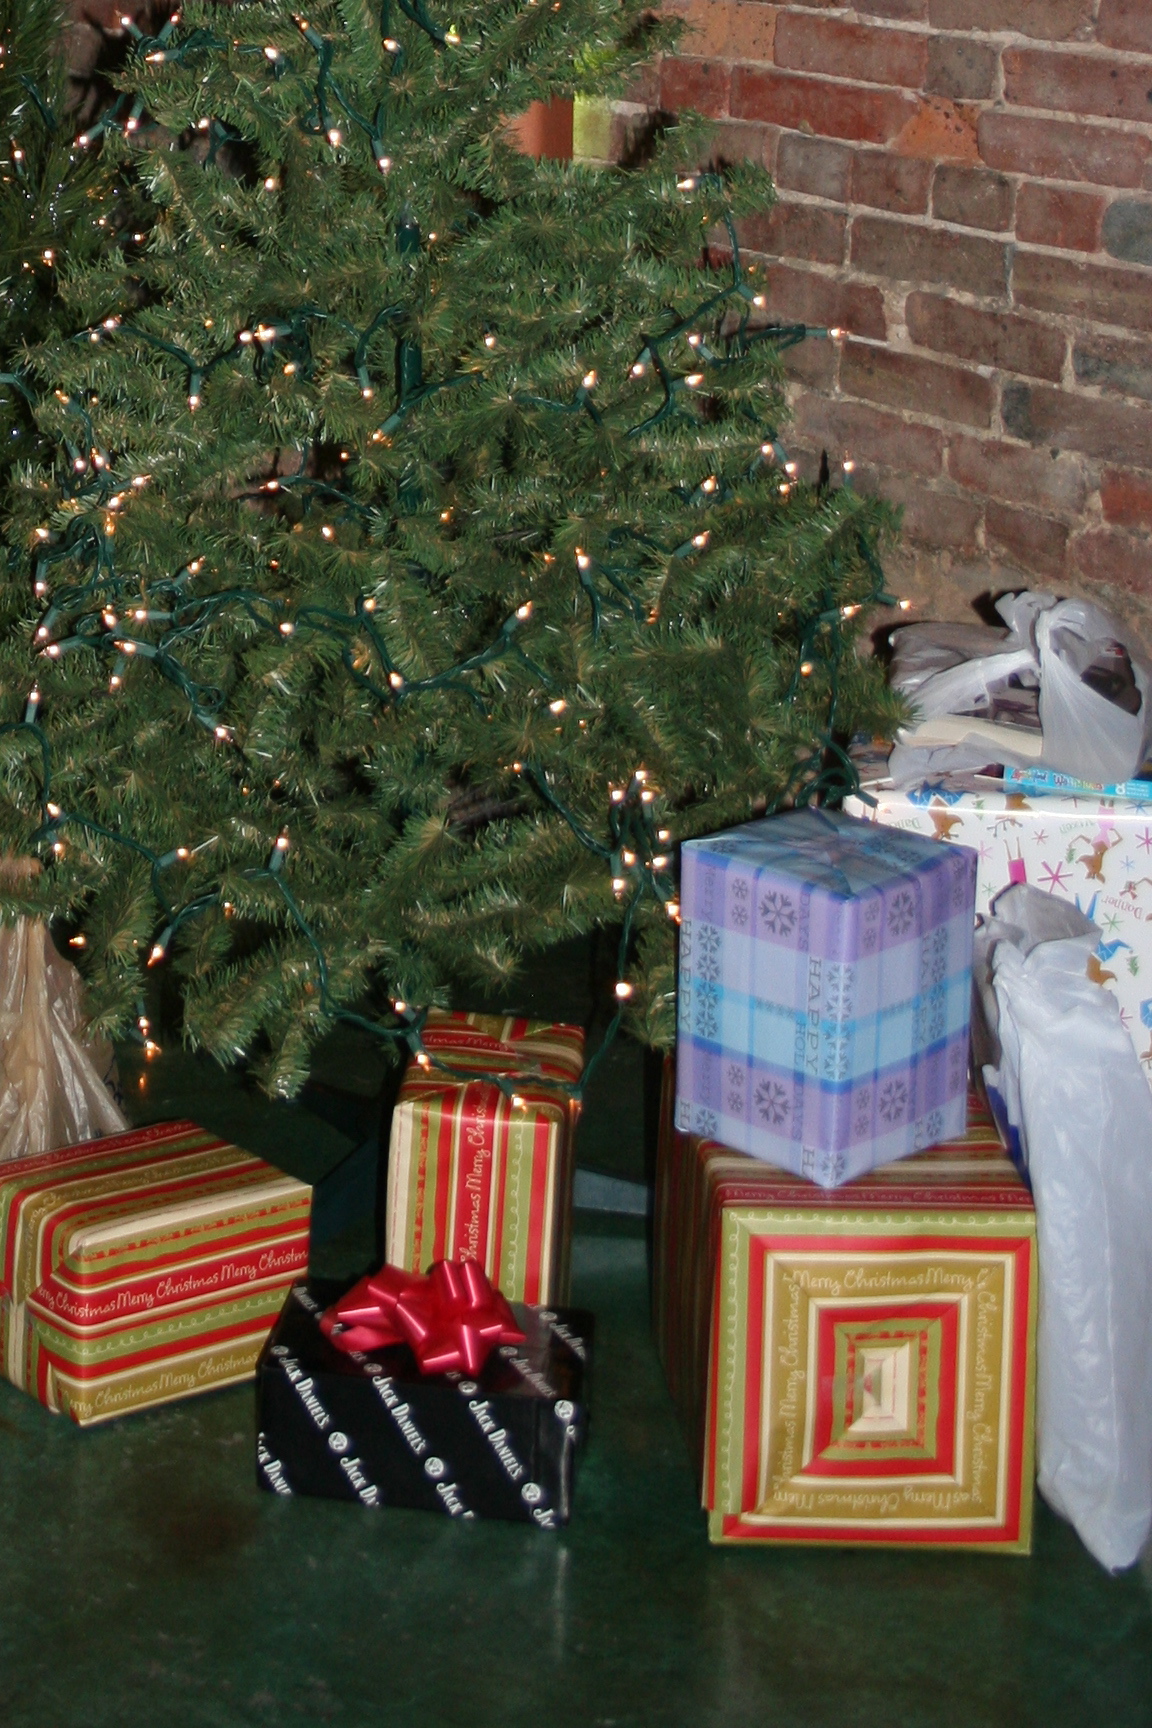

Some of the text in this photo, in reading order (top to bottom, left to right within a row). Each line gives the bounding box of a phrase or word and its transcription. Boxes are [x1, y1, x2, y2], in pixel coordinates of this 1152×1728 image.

[677, 919, 693, 1033] HAPPY
[804, 956, 823, 1077] HAPPY
[465, 1147, 491, 1192] Merry
[55, 1292, 118, 1318] Christmas
[116, 1291, 155, 1310] Merry
[156, 1272, 220, 1298] Christmas
[220, 1264, 258, 1282] Merry
[258, 1248, 308, 1272] Christm
[797, 1267, 974, 1295] Merry Christmas Merry
[975, 1290, 997, 1372] Christmas
[94, 1380, 160, 1408] Christmas
[159, 1371, 197, 1392] Merry
[197, 1350, 259, 1379] Christmas
[371, 1375, 399, 1409] JACK
[966, 1372, 993, 1421] Merry
[468, 1399, 497, 1435] JACK
[339, 1456, 370, 1492] JACK
[435, 1482, 465, 1517] JACK
